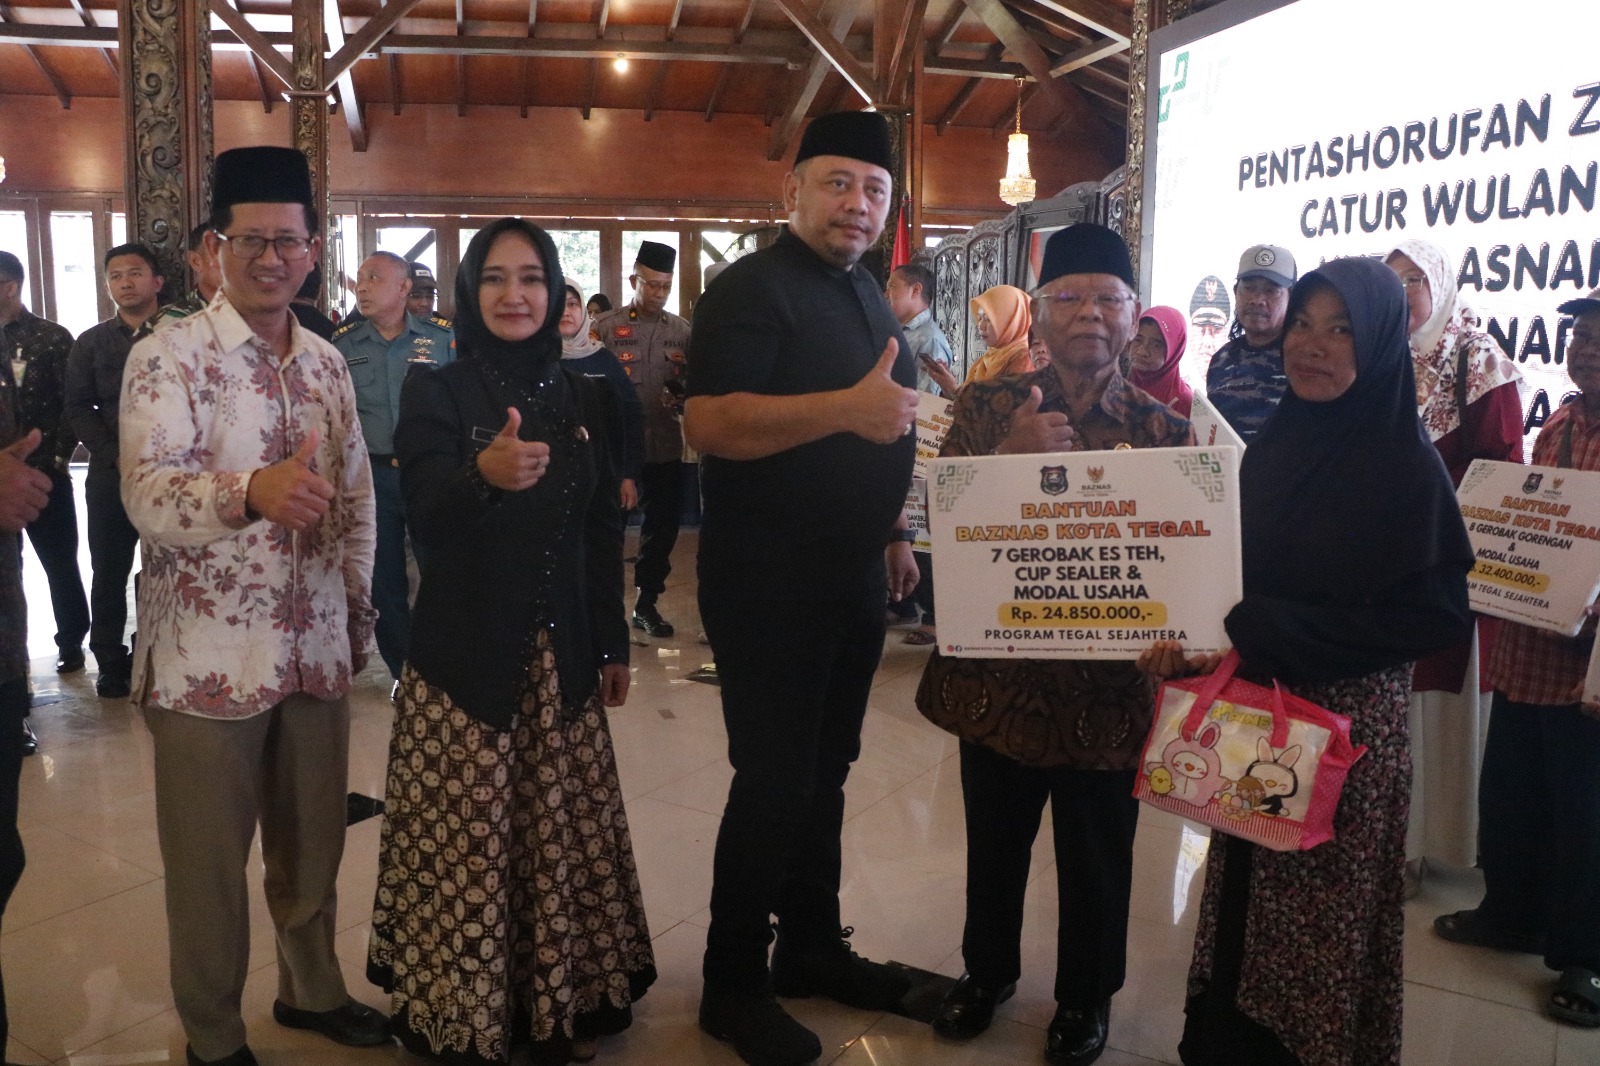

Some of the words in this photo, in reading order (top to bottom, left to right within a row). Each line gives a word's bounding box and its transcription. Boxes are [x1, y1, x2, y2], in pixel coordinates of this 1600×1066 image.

[1238, 93, 1551, 191] PENTASHORUFAN
[1300, 188, 1407, 238] CATUR
[1422, 161, 1599, 227] WULAN
[922, 438, 941, 450] MUA
[1021, 500, 1136, 519] BANTUAN
[1500, 495, 1571, 518] BANTUAN
[1460, 504, 1511, 525] BAZNAS
[1512, 514, 1552, 532] KOTA
[955, 524, 1049, 542] BAZNAS
[1056, 522, 1121, 540] KOTA
[1128, 520, 1211, 538] TEGAL
[1469, 522, 1476, 531] 8
[1476, 523, 1517, 540] GEROBAK
[1518, 531, 1573, 550] GORENGAN
[991, 548, 1002, 563] 7
[1006, 546, 1094, 562] GEROBAK
[1099, 545, 1121, 561] ES
[1124, 545, 1165, 563] TEH,
[1507, 542, 1516, 552] &
[1476, 548, 1507, 563] MODAL
[1508, 556, 1540, 570] USAHA
[1015, 566, 1050, 581] CUP
[1055, 565, 1122, 581] SEALER
[1126, 564, 1142, 580] &
[1479, 564, 1541, 587] 32.400.000,-
[1014, 585, 1079, 600] MODAL
[1084, 584, 1149, 600] USAHA
[1478, 584, 1502, 598] TEGAL
[1503, 590, 1550, 610] SEJAHTERA
[1011, 606, 1037, 622] Rp.
[1042, 605, 1153, 622] 24.850.000,-
[984, 629, 1055, 640] PROGRAM
[1058, 629, 1102, 640] TEGAL
[1107, 629, 1187, 641] SEJAHTERA
